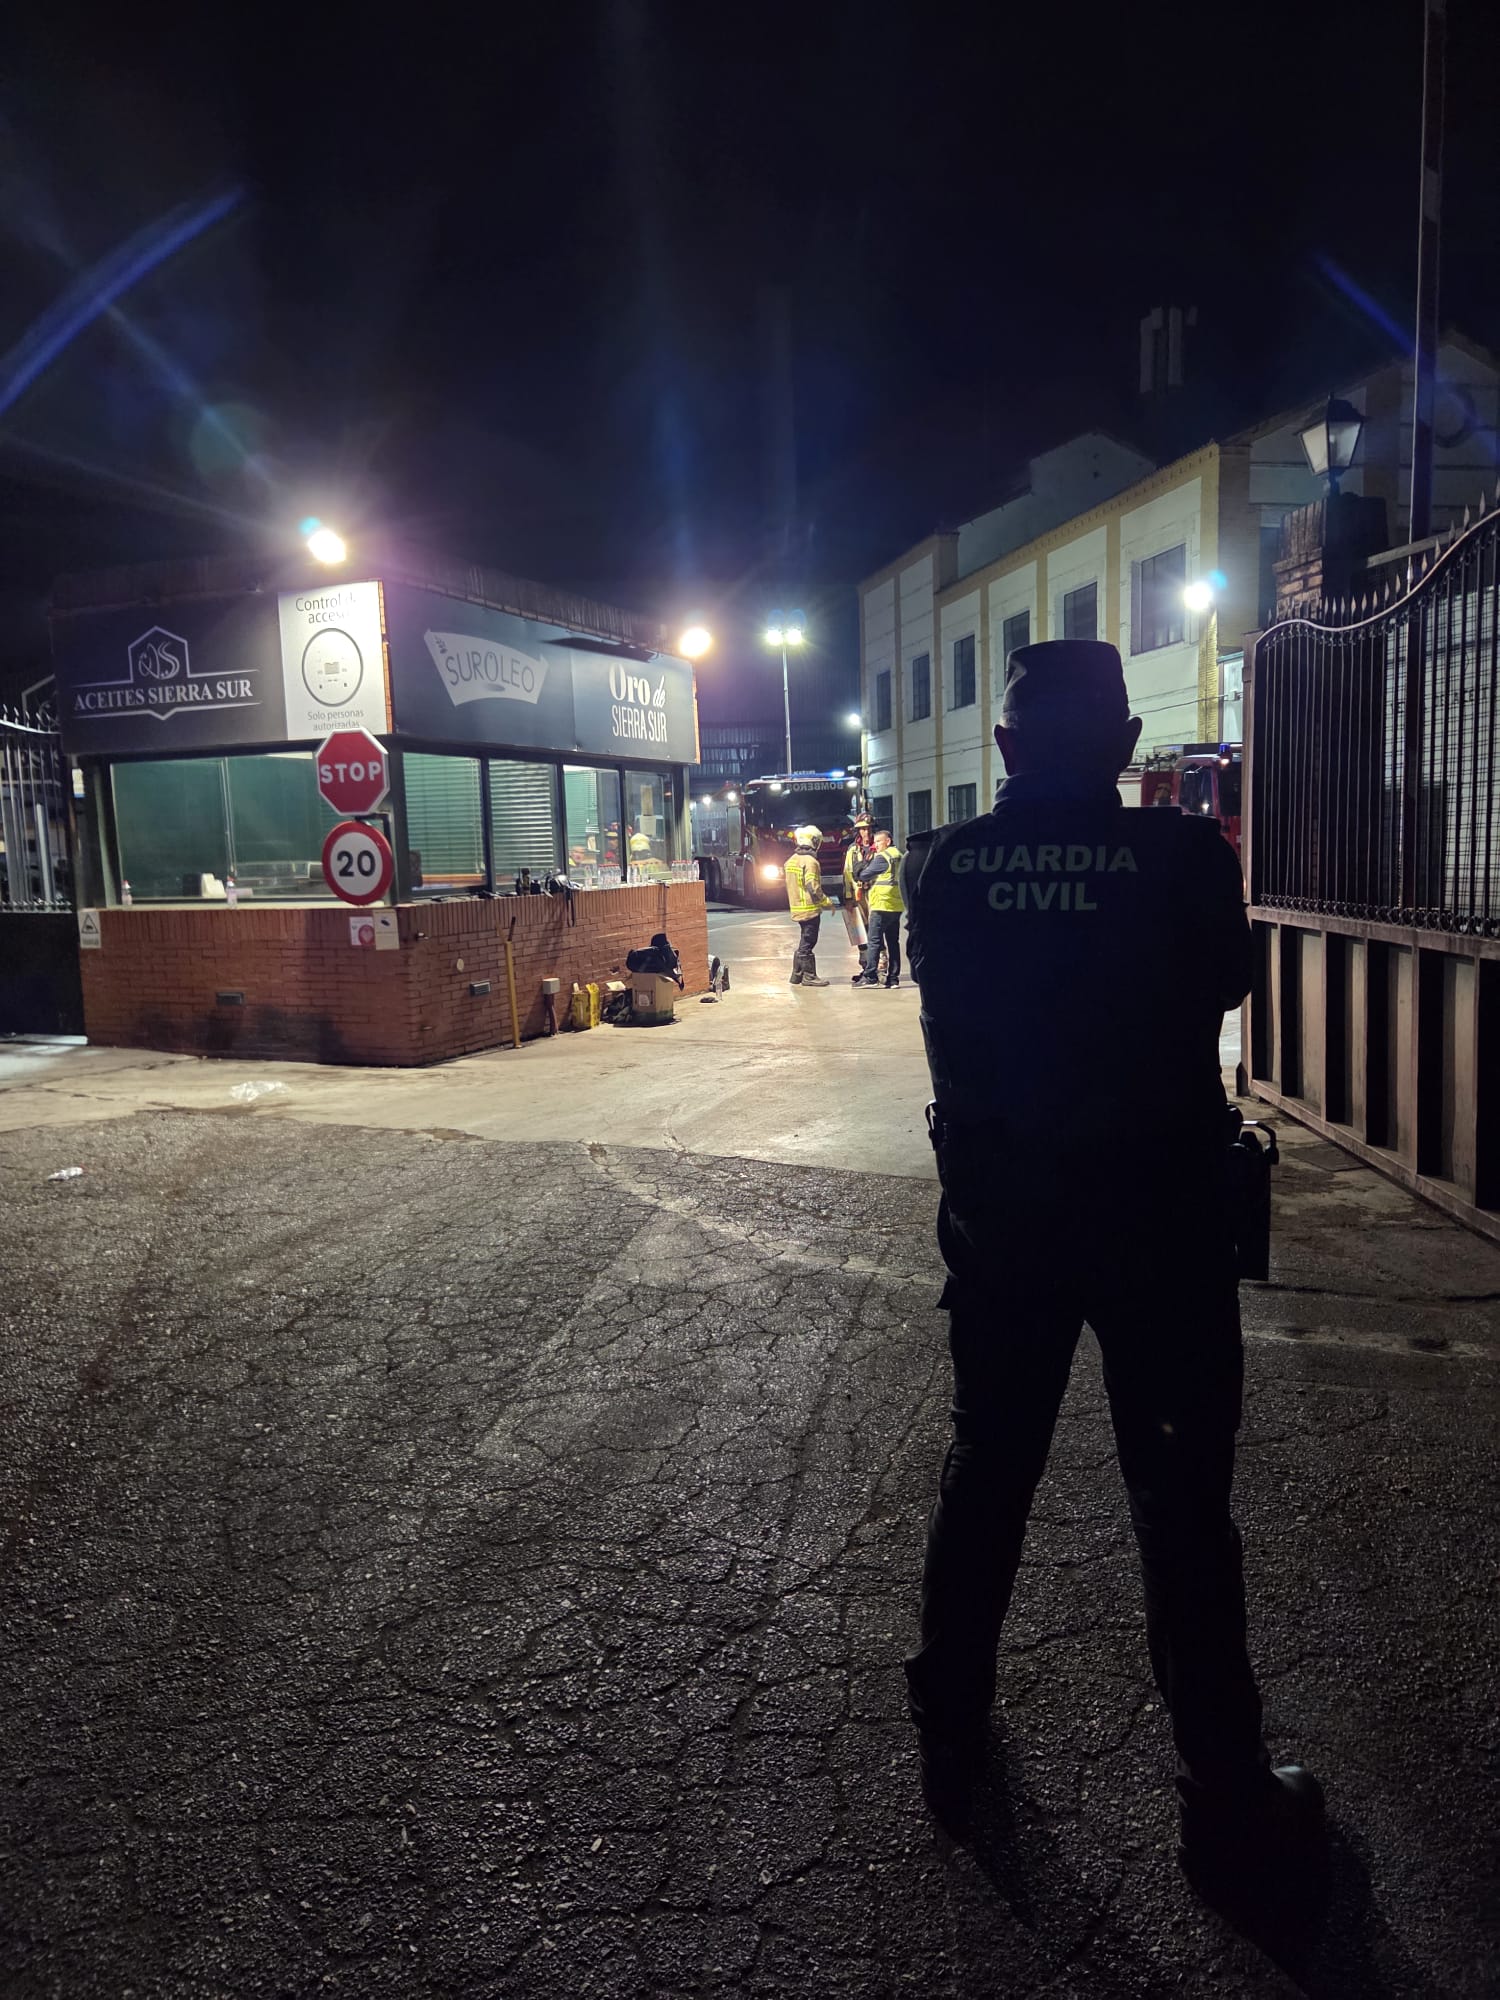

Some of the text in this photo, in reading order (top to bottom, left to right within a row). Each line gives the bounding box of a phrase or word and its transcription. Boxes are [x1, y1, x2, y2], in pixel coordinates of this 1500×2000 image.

[295, 592, 341, 612] Control
[74, 679, 253, 711] ACEITES SIERRA SUR
[609, 662, 666, 708] Oro de
[307, 709, 364, 721] Solo personas
[611, 704, 668, 743] SIERRA SUR
[320, 761, 382, 783] STOP
[337, 850, 376, 877] 20
[950, 844, 1139, 874] GUARDIA
[987, 881, 1098, 911] CIVIL
